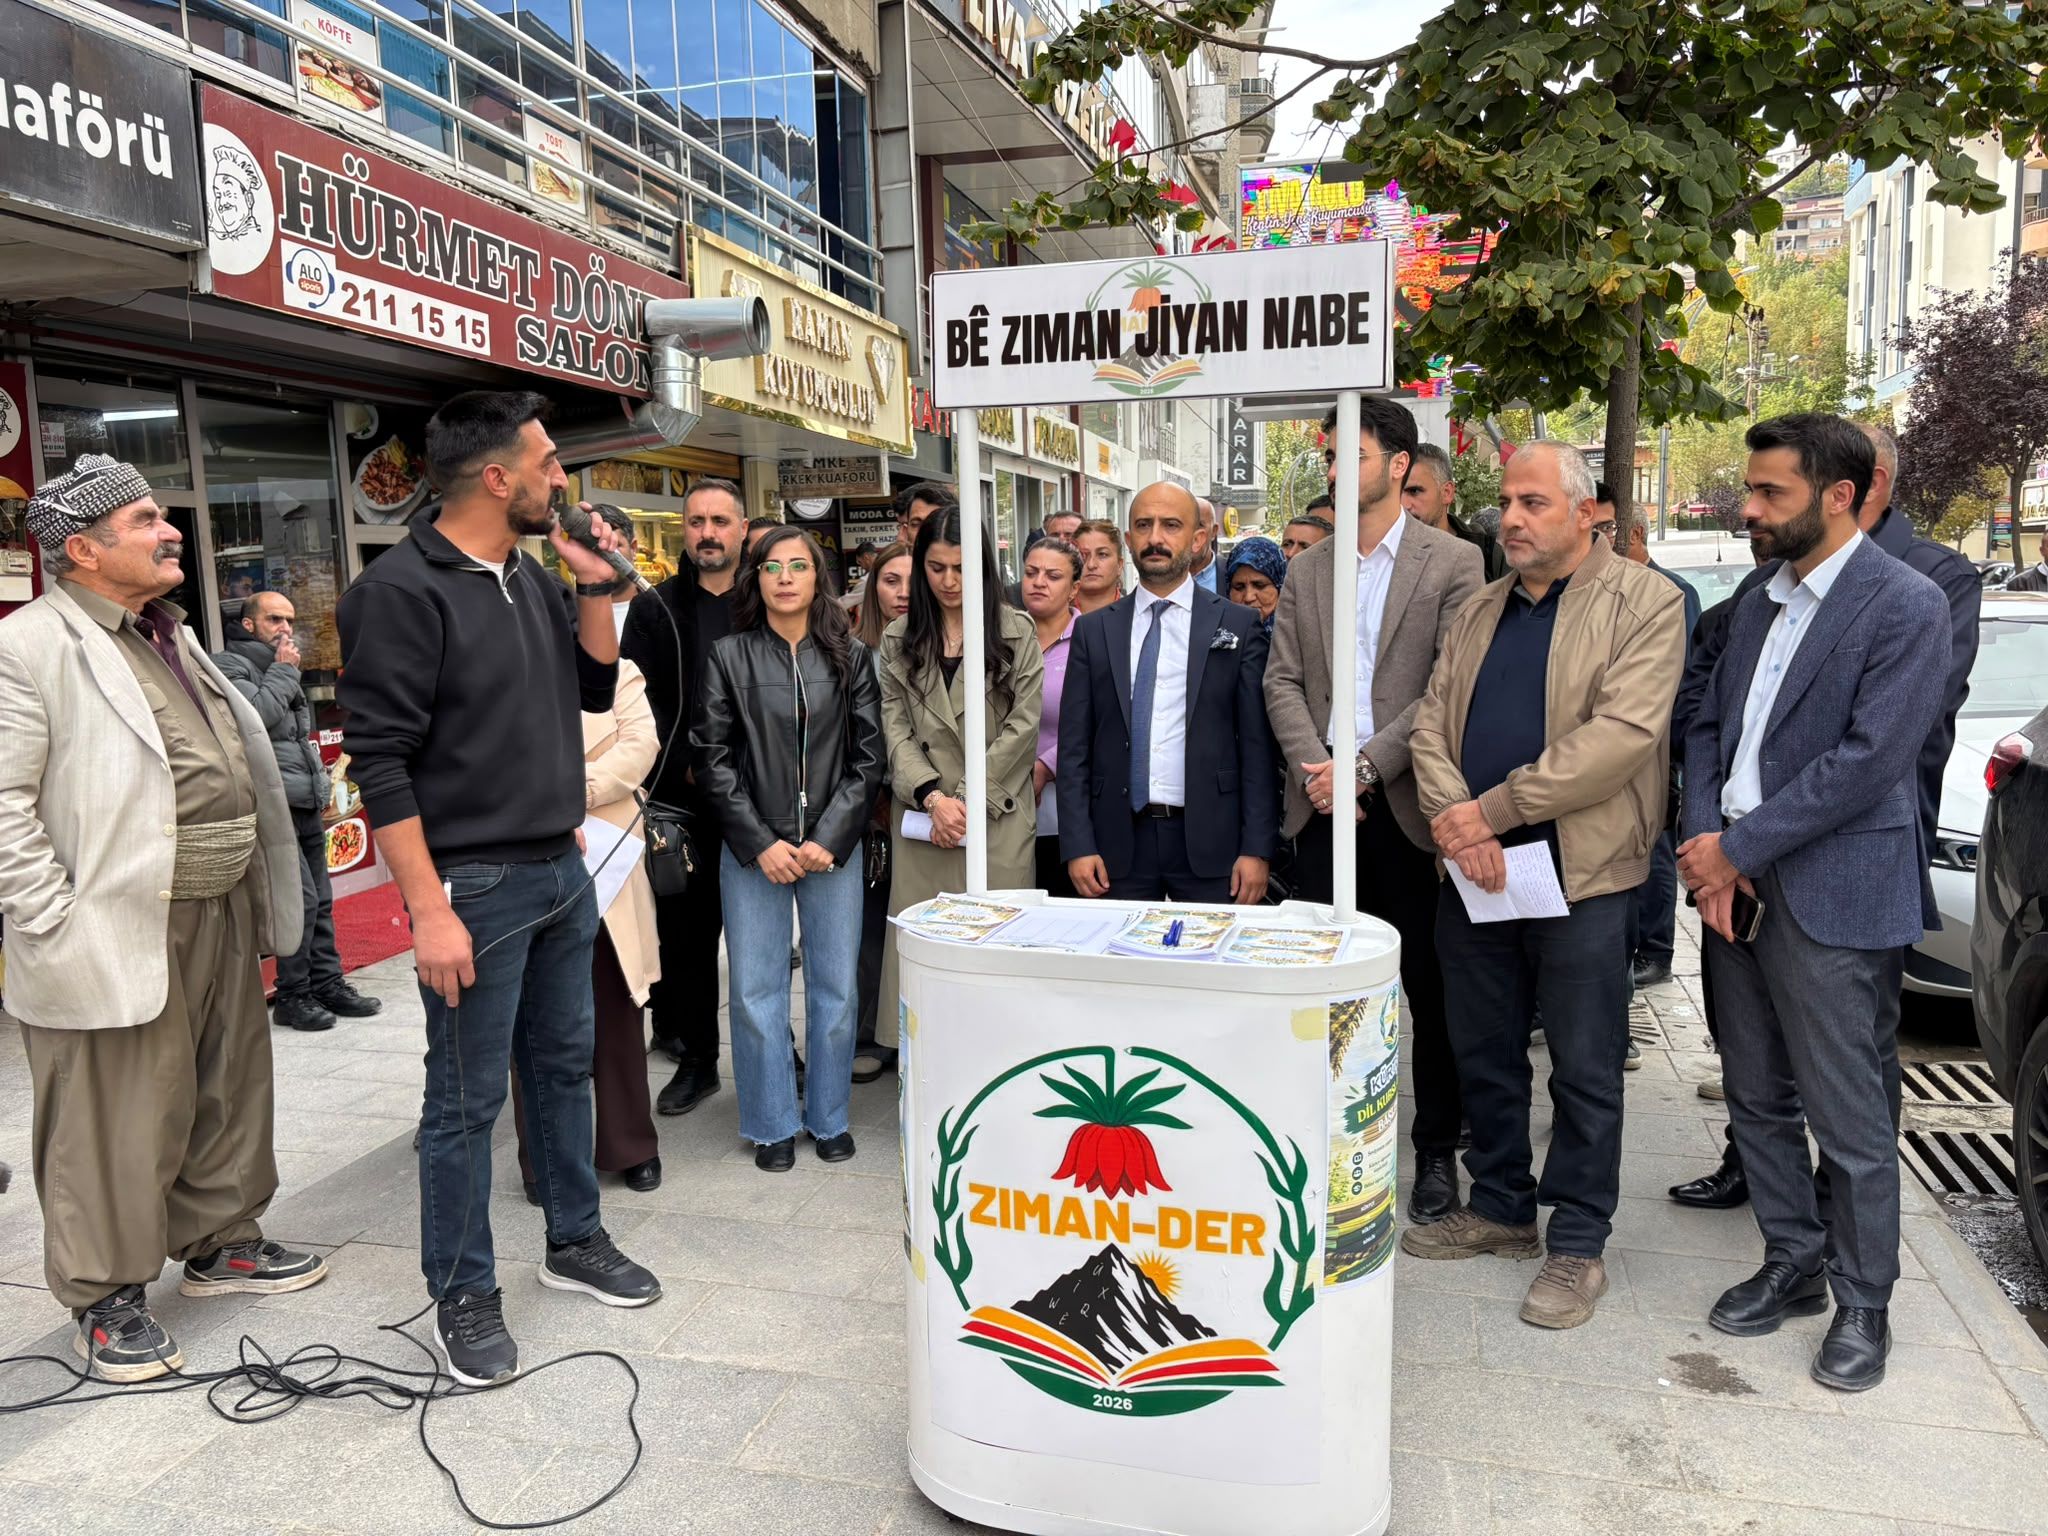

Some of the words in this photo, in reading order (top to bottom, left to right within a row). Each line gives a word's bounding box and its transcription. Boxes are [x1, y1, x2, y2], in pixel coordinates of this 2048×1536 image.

[317, 17, 353, 45] KÖFTE
[544, 131, 563, 149] TOST
[275, 151, 541, 311] HÜRMET
[300, 263, 322, 282] ALO
[341, 281, 397, 326] 211
[411, 302, 445, 338] 15
[455, 314, 487, 349] 15
[946, 305, 990, 368] BÊ
[1001, 308, 1121, 366] ZIMAN
[1135, 294, 1247, 358] JİYAN
[1263, 291, 1370, 350] NABE
[849, 510, 884, 520] MODA
[1357, 1102, 1376, 1123] DİL
[968, 1182, 1266, 1256] ZIMAN-DER
[1097, 1286, 1109, 1300] X
[1048, 1297, 1060, 1309] W
[1080, 1303, 1090, 1318] Q
[1092, 1394, 1133, 1411] 2026
